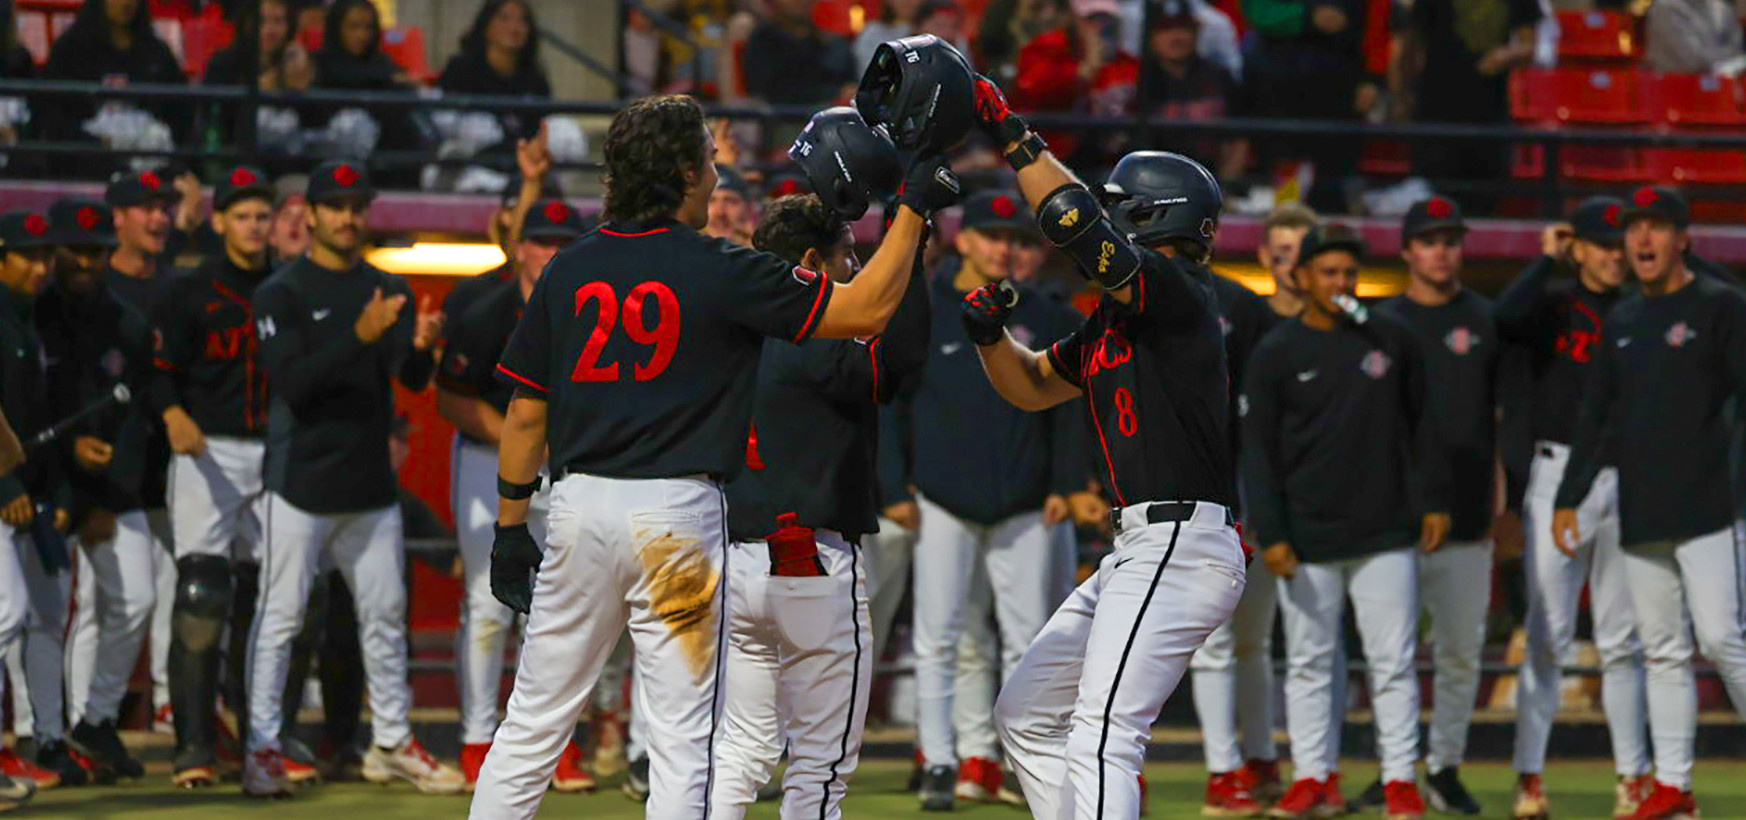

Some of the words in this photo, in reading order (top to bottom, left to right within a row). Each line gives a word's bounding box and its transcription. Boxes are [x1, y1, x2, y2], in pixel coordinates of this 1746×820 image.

[905, 50, 920, 64] TG
[800, 141, 813, 156] TG
[571, 281, 681, 382] 29
[1115, 387, 1138, 437] 8
